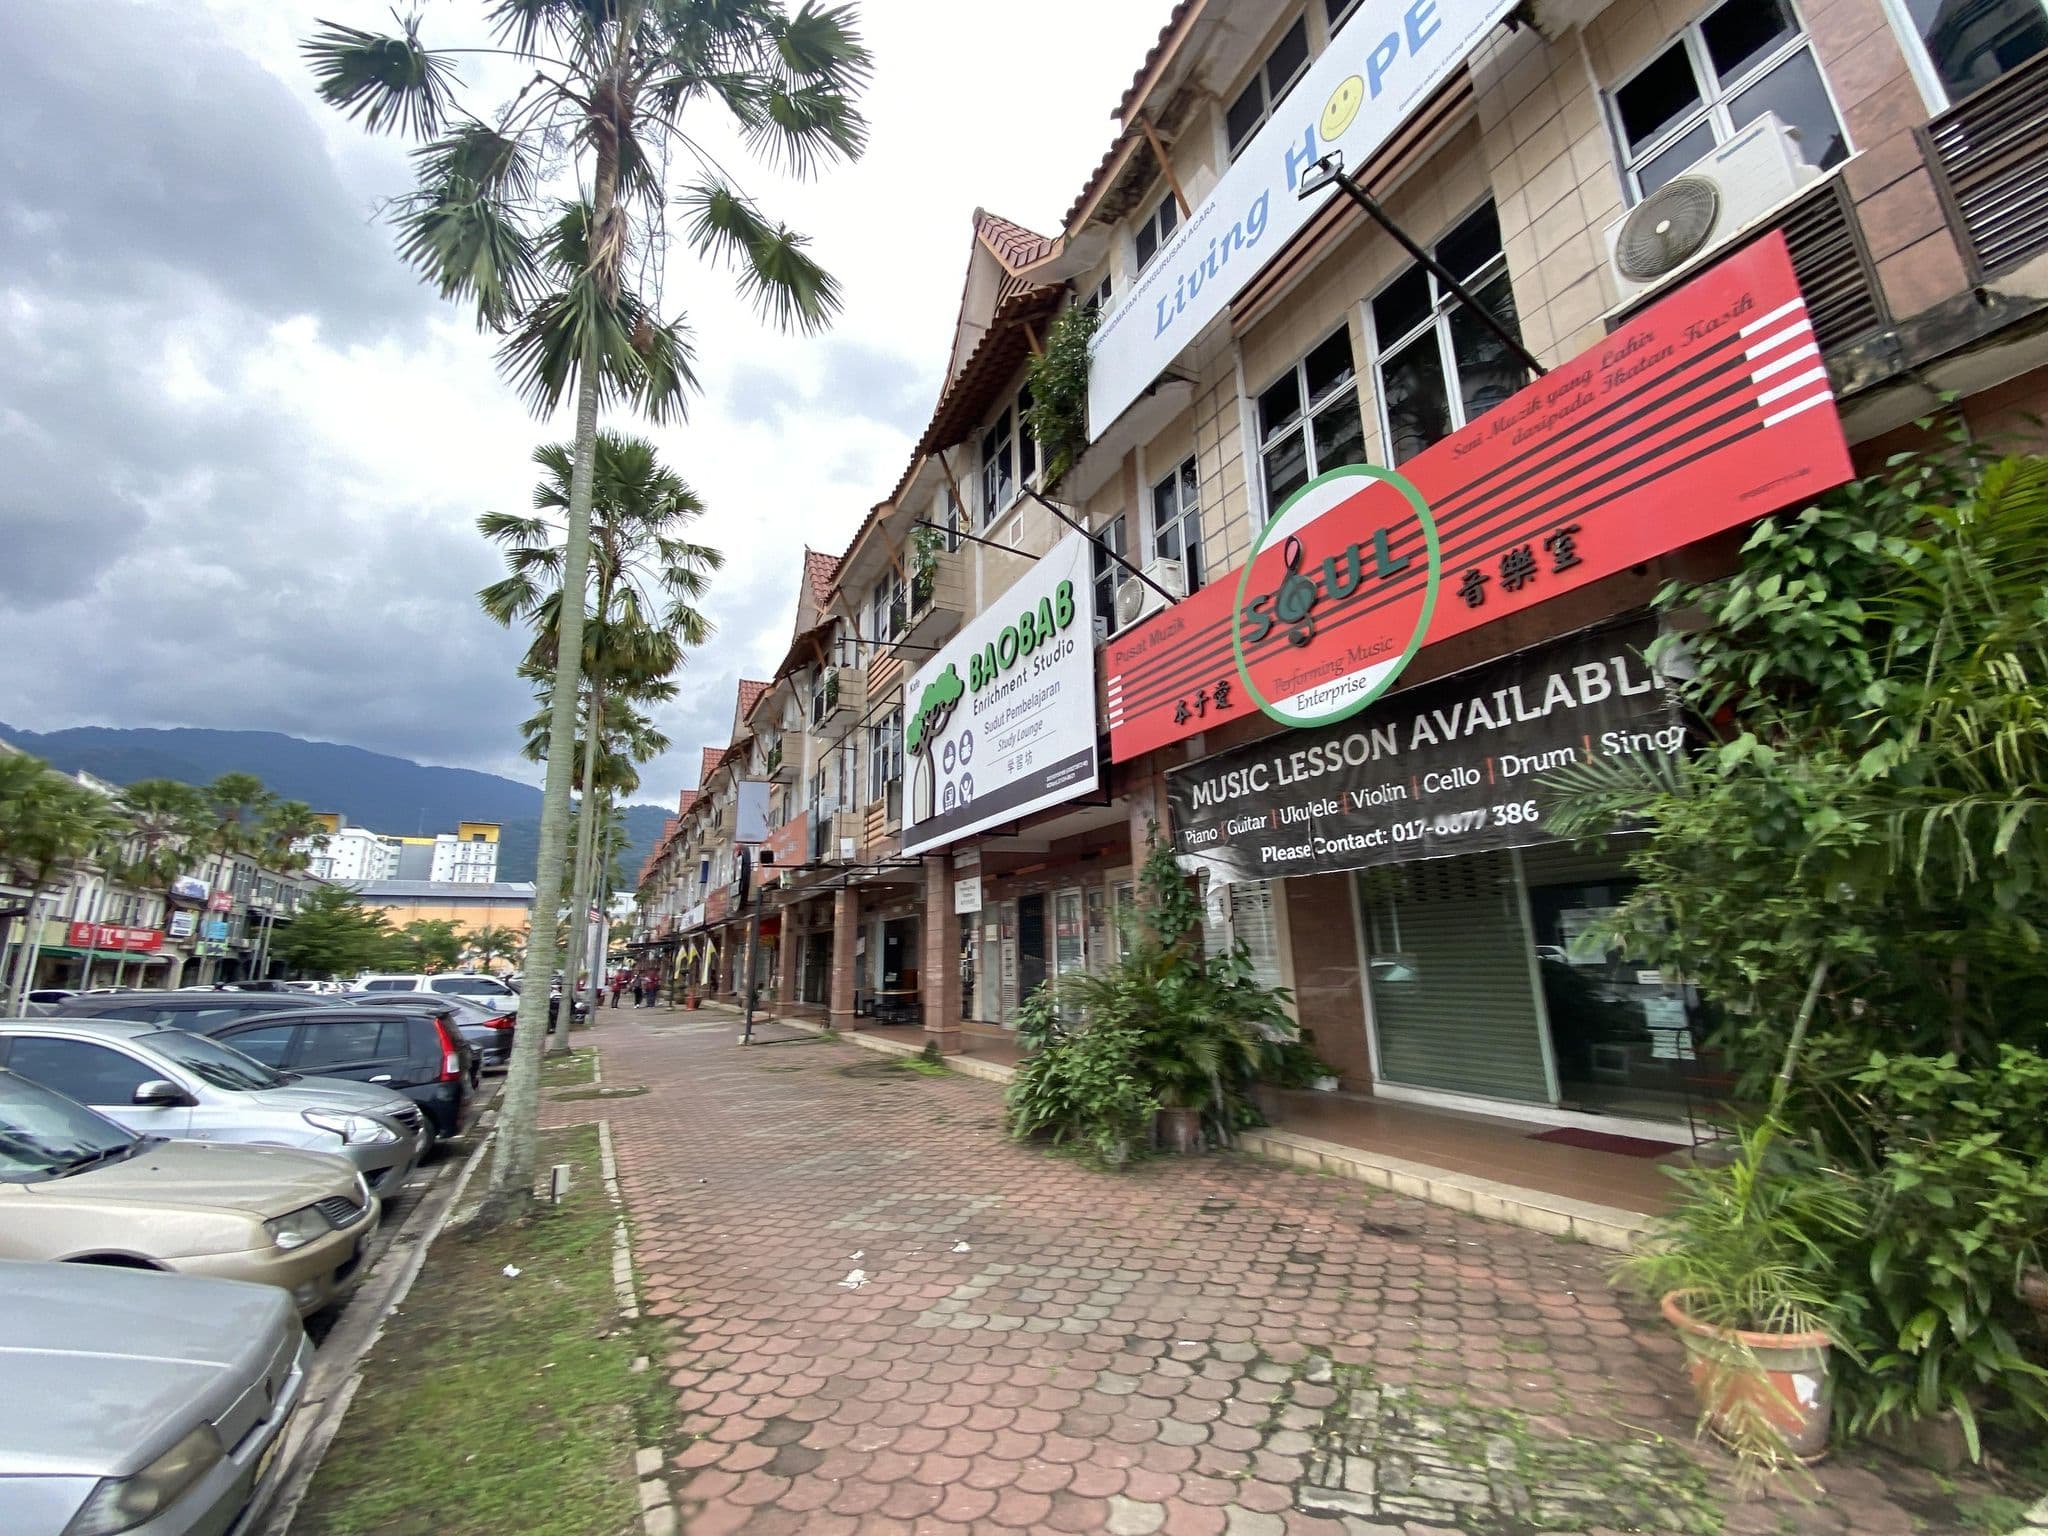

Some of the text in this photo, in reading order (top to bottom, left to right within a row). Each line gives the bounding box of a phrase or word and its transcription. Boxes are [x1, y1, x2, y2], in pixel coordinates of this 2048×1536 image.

[1138, 236, 1187, 298] PENGURUSAN
[1187, 201, 1216, 239] ACARA
[1154, 188, 1269, 340] Living
[1451, 330, 1655, 461] Seni Muzik yang Lahir
[1512, 290, 1756, 447] daripada Ikatan Kasih
[969, 579, 1075, 693] BAOBAB
[1115, 640, 1147, 665] Pusat
[1273, 636, 1393, 696] Performing Music
[973, 639, 1074, 716] Enrichment Studio
[984, 681, 1060, 735] Sudut Pembelajaran
[1296, 675, 1367, 711] Enterprise
[998, 719, 1043, 752] Study Lounge
[1192, 763, 1270, 810] MUSIC
[1274, 723, 1399, 786] LESSON
[1185, 828, 1218, 844] Piano
[1227, 815, 1267, 836] Guitar
[1280, 798, 1339, 825] Ukulele
[1351, 784, 1408, 809] Violin
[1424, 766, 1481, 794] Cello
[1500, 746, 1577, 778] Drum
[1261, 843, 1311, 863] Please
